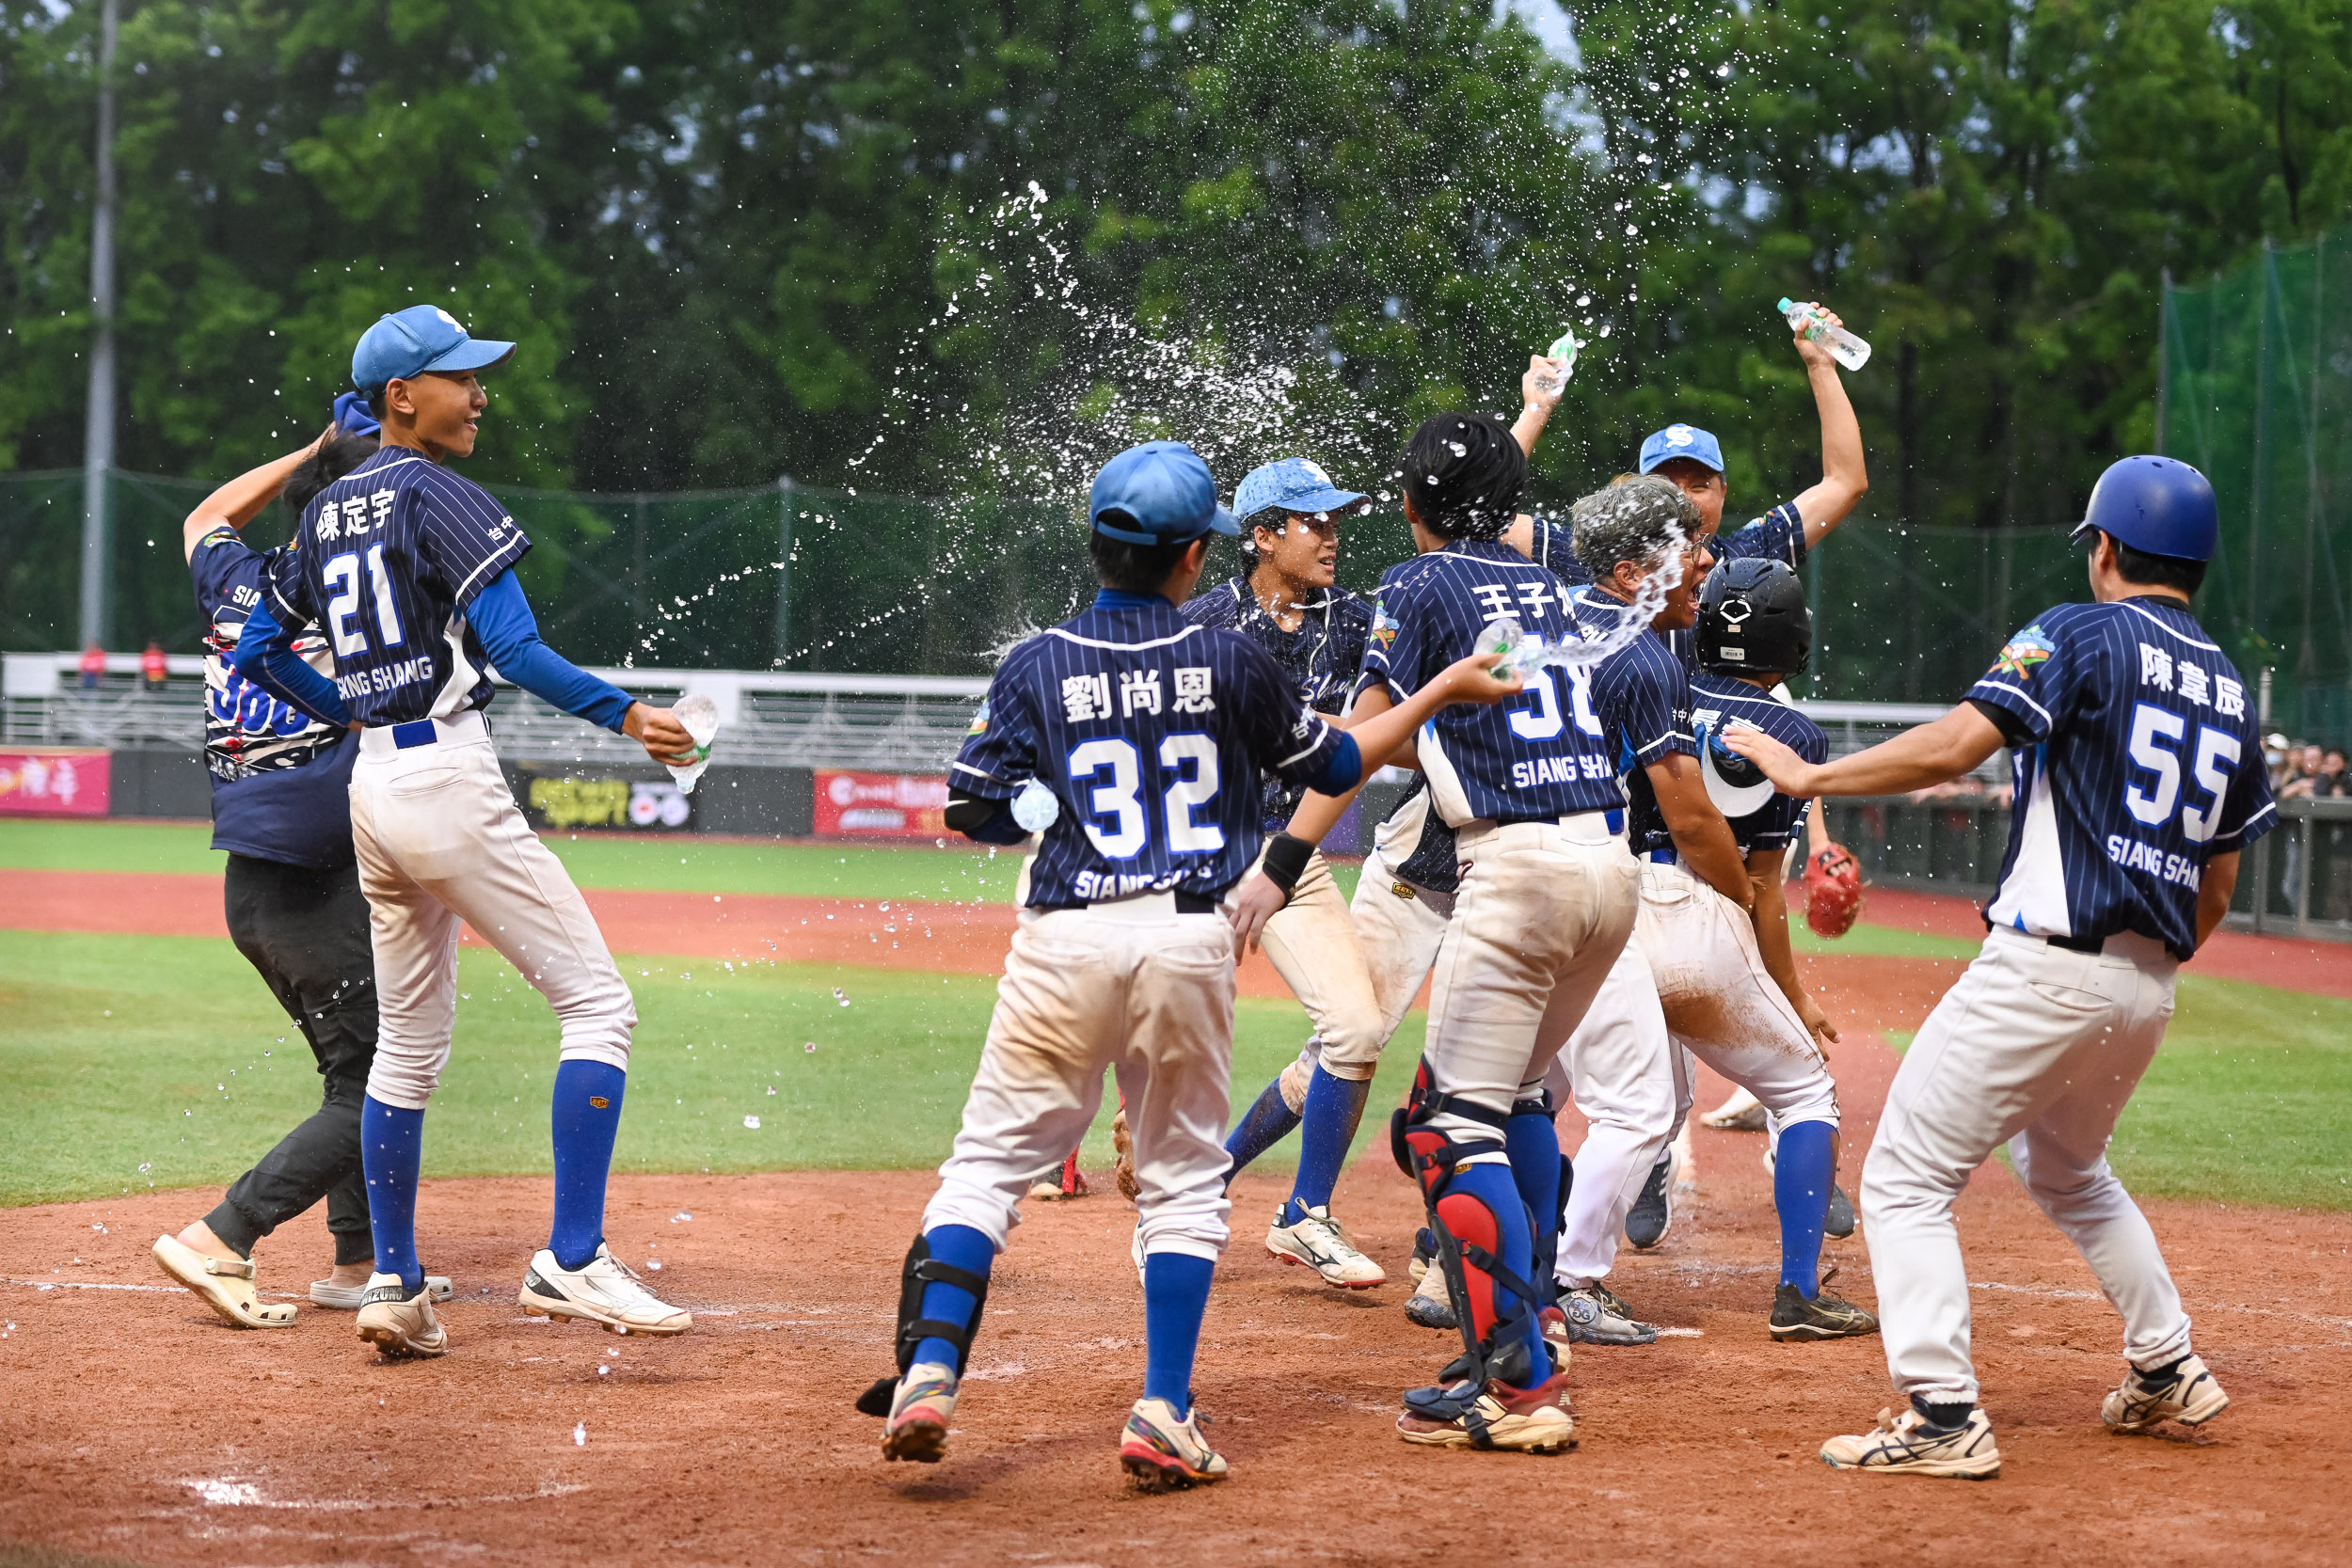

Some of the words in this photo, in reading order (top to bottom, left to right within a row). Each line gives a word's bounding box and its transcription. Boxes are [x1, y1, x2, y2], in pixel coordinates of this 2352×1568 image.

[316, 487, 395, 544] 陳定宇
[323, 541, 405, 660] 21
[371, 654, 434, 694] SHANG
[1061, 666, 1217, 723] 劉尚恩
[1066, 730, 1226, 861] 32
[1511, 755, 1578, 790] SIANG
[2123, 701, 2243, 845] 55
[2106, 833, 2164, 879] SIANG
